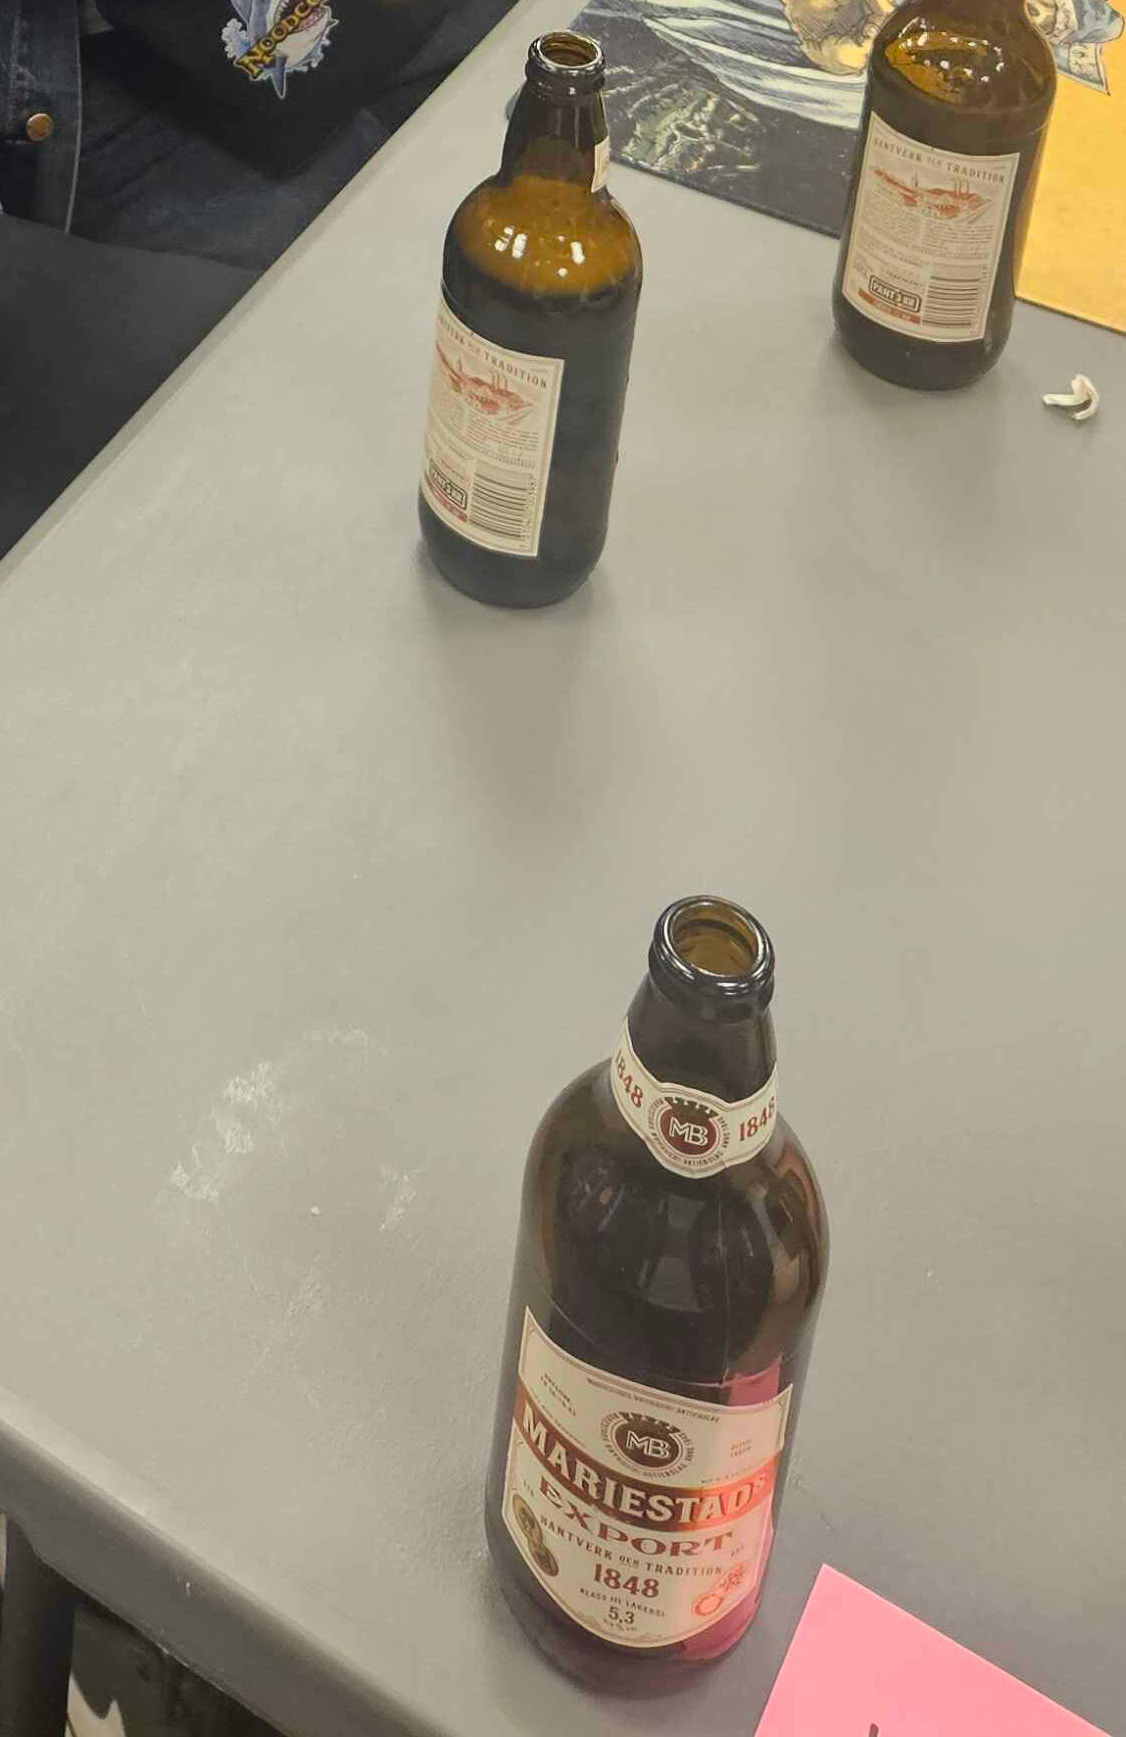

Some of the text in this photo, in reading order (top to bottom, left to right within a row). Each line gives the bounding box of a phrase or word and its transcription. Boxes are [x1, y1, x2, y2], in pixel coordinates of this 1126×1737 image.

[946, 162, 1005, 184] TRADITION
[668, 1116, 708, 1146] MB
[626, 1429, 670, 1460] MB
[522, 1402, 771, 1528] MARIESTADS
[539, 1477, 734, 1558] EXPORT
[539, 1515, 614, 1562] HANTVERK
[645, 1561, 724, 1577] TRADITION
[593, 1562, 661, 1599] 1848
